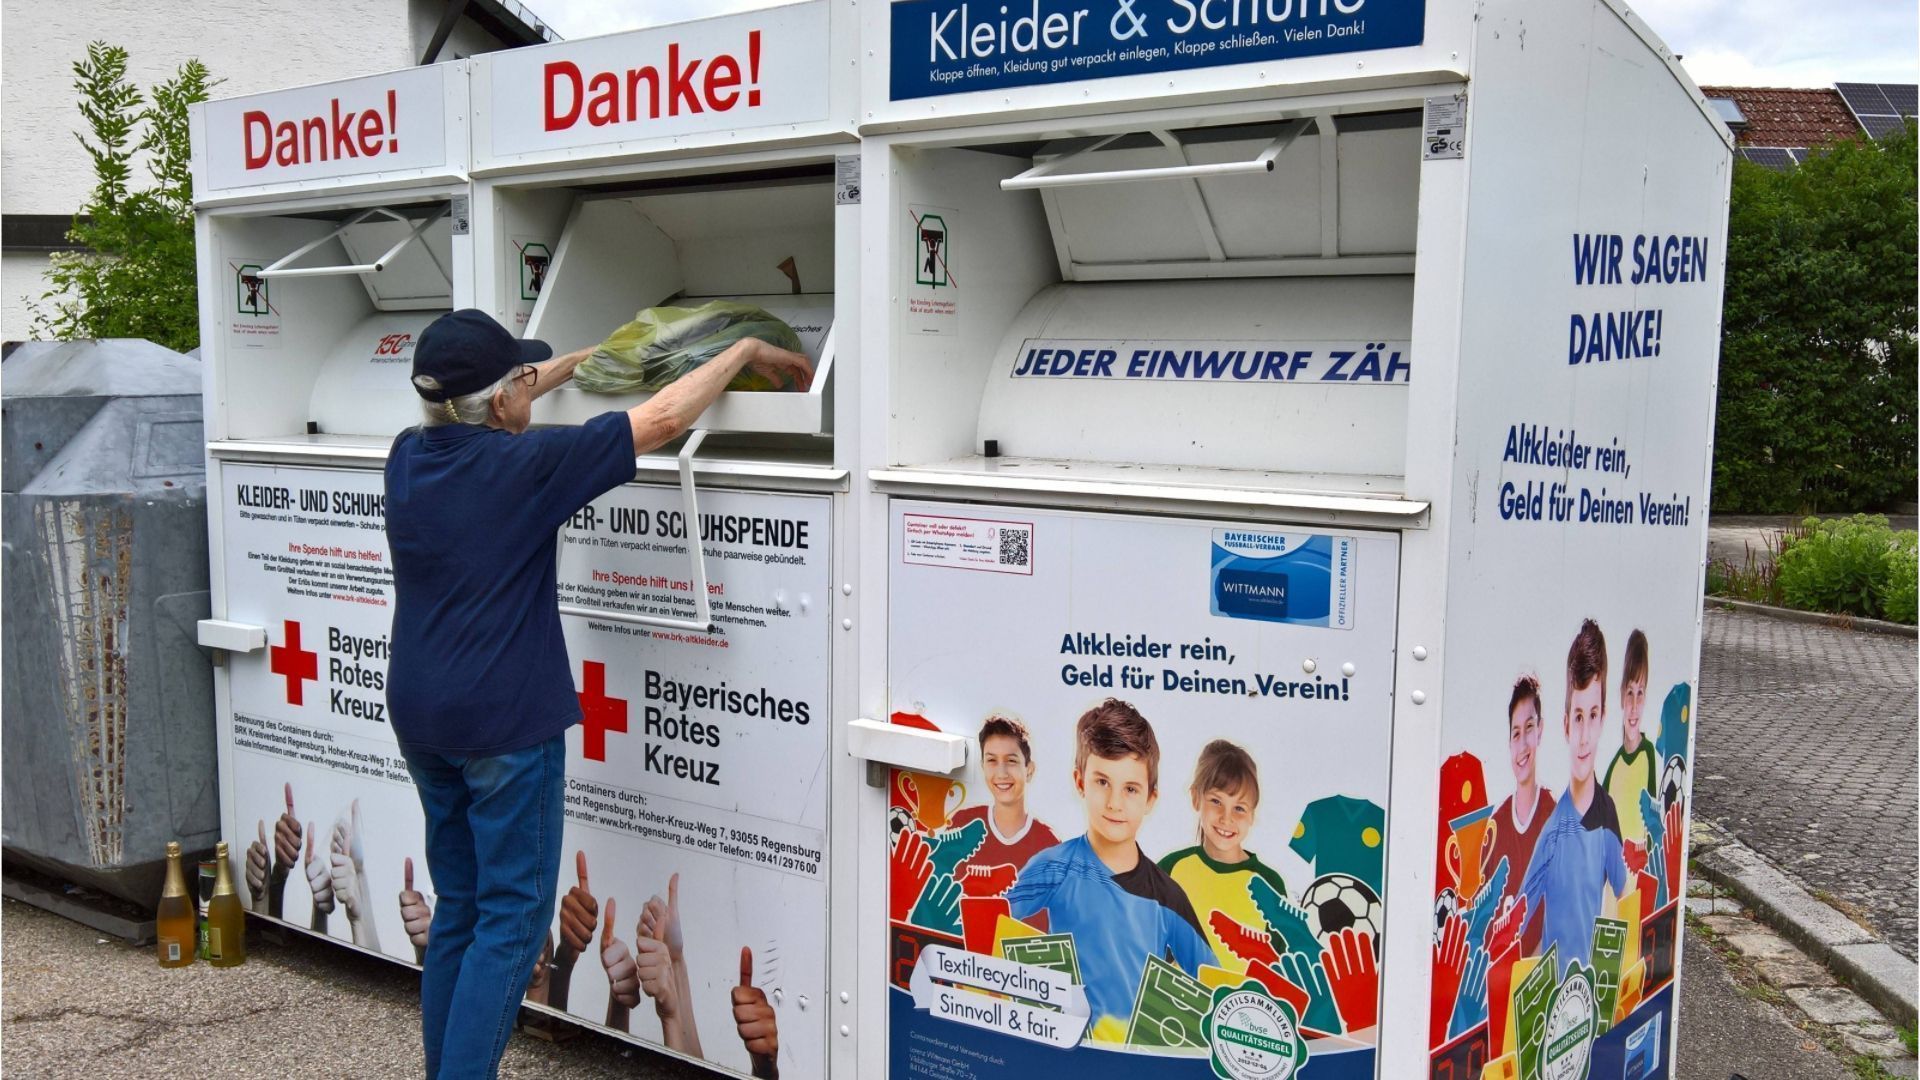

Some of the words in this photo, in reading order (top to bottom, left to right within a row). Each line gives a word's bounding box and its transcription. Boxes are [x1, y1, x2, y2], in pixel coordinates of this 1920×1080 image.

[930, 0, 1089, 63] Kleider
[930, 69, 964, 84] Klappe
[966, 64, 1000, 78] öffnen,
[1003, 59, 1048, 74] Kleidung
[1051, 57, 1068, 72] gut
[1071, 51, 1117, 68] verpackt
[1119, 45, 1171, 62] einlegen,
[1174, 41, 1216, 57] Klappe
[1219, 31, 1279, 51] schließen.
[1284, 26, 1323, 42] Vielen
[1327, 20, 1365, 38] Dank!
[543, 30, 761, 133] Danke!
[243, 90, 400, 171] Danke!
[1573, 233, 1623, 285] WIR
[1631, 234, 1709, 285] SAGEN
[1568, 309, 1663, 366] DANKE!
[1015, 348, 1118, 378] JEDER
[1126, 350, 1313, 382] EINWURF
[1504, 422, 1592, 470] Altkleider
[1595, 436, 1631, 480] rein,
[237, 484, 296, 510] KLEIDER-
[300, 488, 328, 513] UND
[1500, 480, 1544, 521] Geld
[1549, 481, 1575, 523] für
[1579, 487, 1634, 525] Deinen
[1640, 492, 1691, 527] Verein!
[610, 506, 650, 536] UND
[1224, 532, 1286, 545] BAYERISCHER
[288, 542, 301, 553] Ihre
[302, 543, 328, 556] Spende
[329, 546, 342, 558] hilft
[344, 550, 356, 559] uns
[358, 549, 382, 562] helfen!
[578, 536, 591, 546] und
[592, 537, 599, 546] in
[600, 537, 618, 548] Tüten
[620, 541, 651, 552] verpackt
[652, 543, 687, 555] einwerfen
[723, 550, 763, 562] paarweise
[764, 553, 807, 566] gebündelt.
[1224, 541, 1286, 552] FUSSBALL-VERBAND
[1340, 540, 1349, 577] PARTNER
[592, 569, 610, 582] Ihre
[612, 571, 648, 586] Spende
[649, 575, 668, 589] hilft
[670, 580, 688, 591] uns
[1223, 582, 1285, 598] WITTMANN
[565, 583, 576, 592] der
[577, 584, 606, 597] Kleidung
[607, 588, 628, 599] geben
[629, 591, 641, 600] wir
[641, 593, 651, 601] an
[651, 593, 672, 604] sozial
[725, 600, 764, 614] Menschen
[765, 606, 792, 618] weiter.
[575, 595, 601, 606] Großteil
[602, 600, 635, 611] verkaufen
[637, 603, 648, 612] wir
[648, 606, 658, 614] an
[659, 606, 670, 615] ein
[1338, 579, 1347, 626] OFFIZIELLER
[588, 621, 613, 632] Weitere
[614, 624, 631, 635] Infos
[633, 628, 651, 637] unter
[652, 630, 729, 649] www.brk-altkleider.de
[1060, 632, 1172, 661] Altkleider
[1179, 637, 1237, 665] rein,
[329, 657, 385, 691] Rotes
[1061, 664, 1113, 690] Geld
[1120, 665, 1155, 692] für
[1163, 668, 1247, 696] Deinen
[1254, 673, 1350, 702] Verein!
[330, 687, 385, 723] Kreuz
[644, 669, 811, 726] Bayerisches
[277, 722, 312, 737] Containers
[312, 730, 334, 743] durch:
[644, 706, 720, 748] Rotes
[234, 724, 247, 736] BRK
[328, 745, 385, 768] Hoher-Kreuz-Weg
[644, 742, 720, 786] Kreuz
[370, 766, 385, 778] oder
[570, 779, 616, 799] Containers
[618, 790, 648, 806] durch:
[576, 810, 598, 824] unter:
[599, 815, 696, 847] www.brk-regensburg.de
[697, 838, 717, 851] oder
[719, 841, 754, 860] Telefon:
[583, 796, 636, 820] Regensburg,
[638, 808, 717, 839] Hoher-Kreuz-Weg
[719, 826, 729, 841] 7,
[730, 829, 759, 846] 93055
[761, 836, 821, 863] Regensburg
[936, 951, 1050, 1002] Textilrecycling
[939, 993, 1002, 1026] Sinnvoll
[1008, 1009, 1021, 1032] &
[1027, 1011, 1059, 1041] fair.
[1217, 995, 1292, 1039] TEXTILSAMMLUNG
[1249, 1021, 1268, 1035] bvse
[1220, 1028, 1290, 1055] QUALITÄTSSIEGEL
